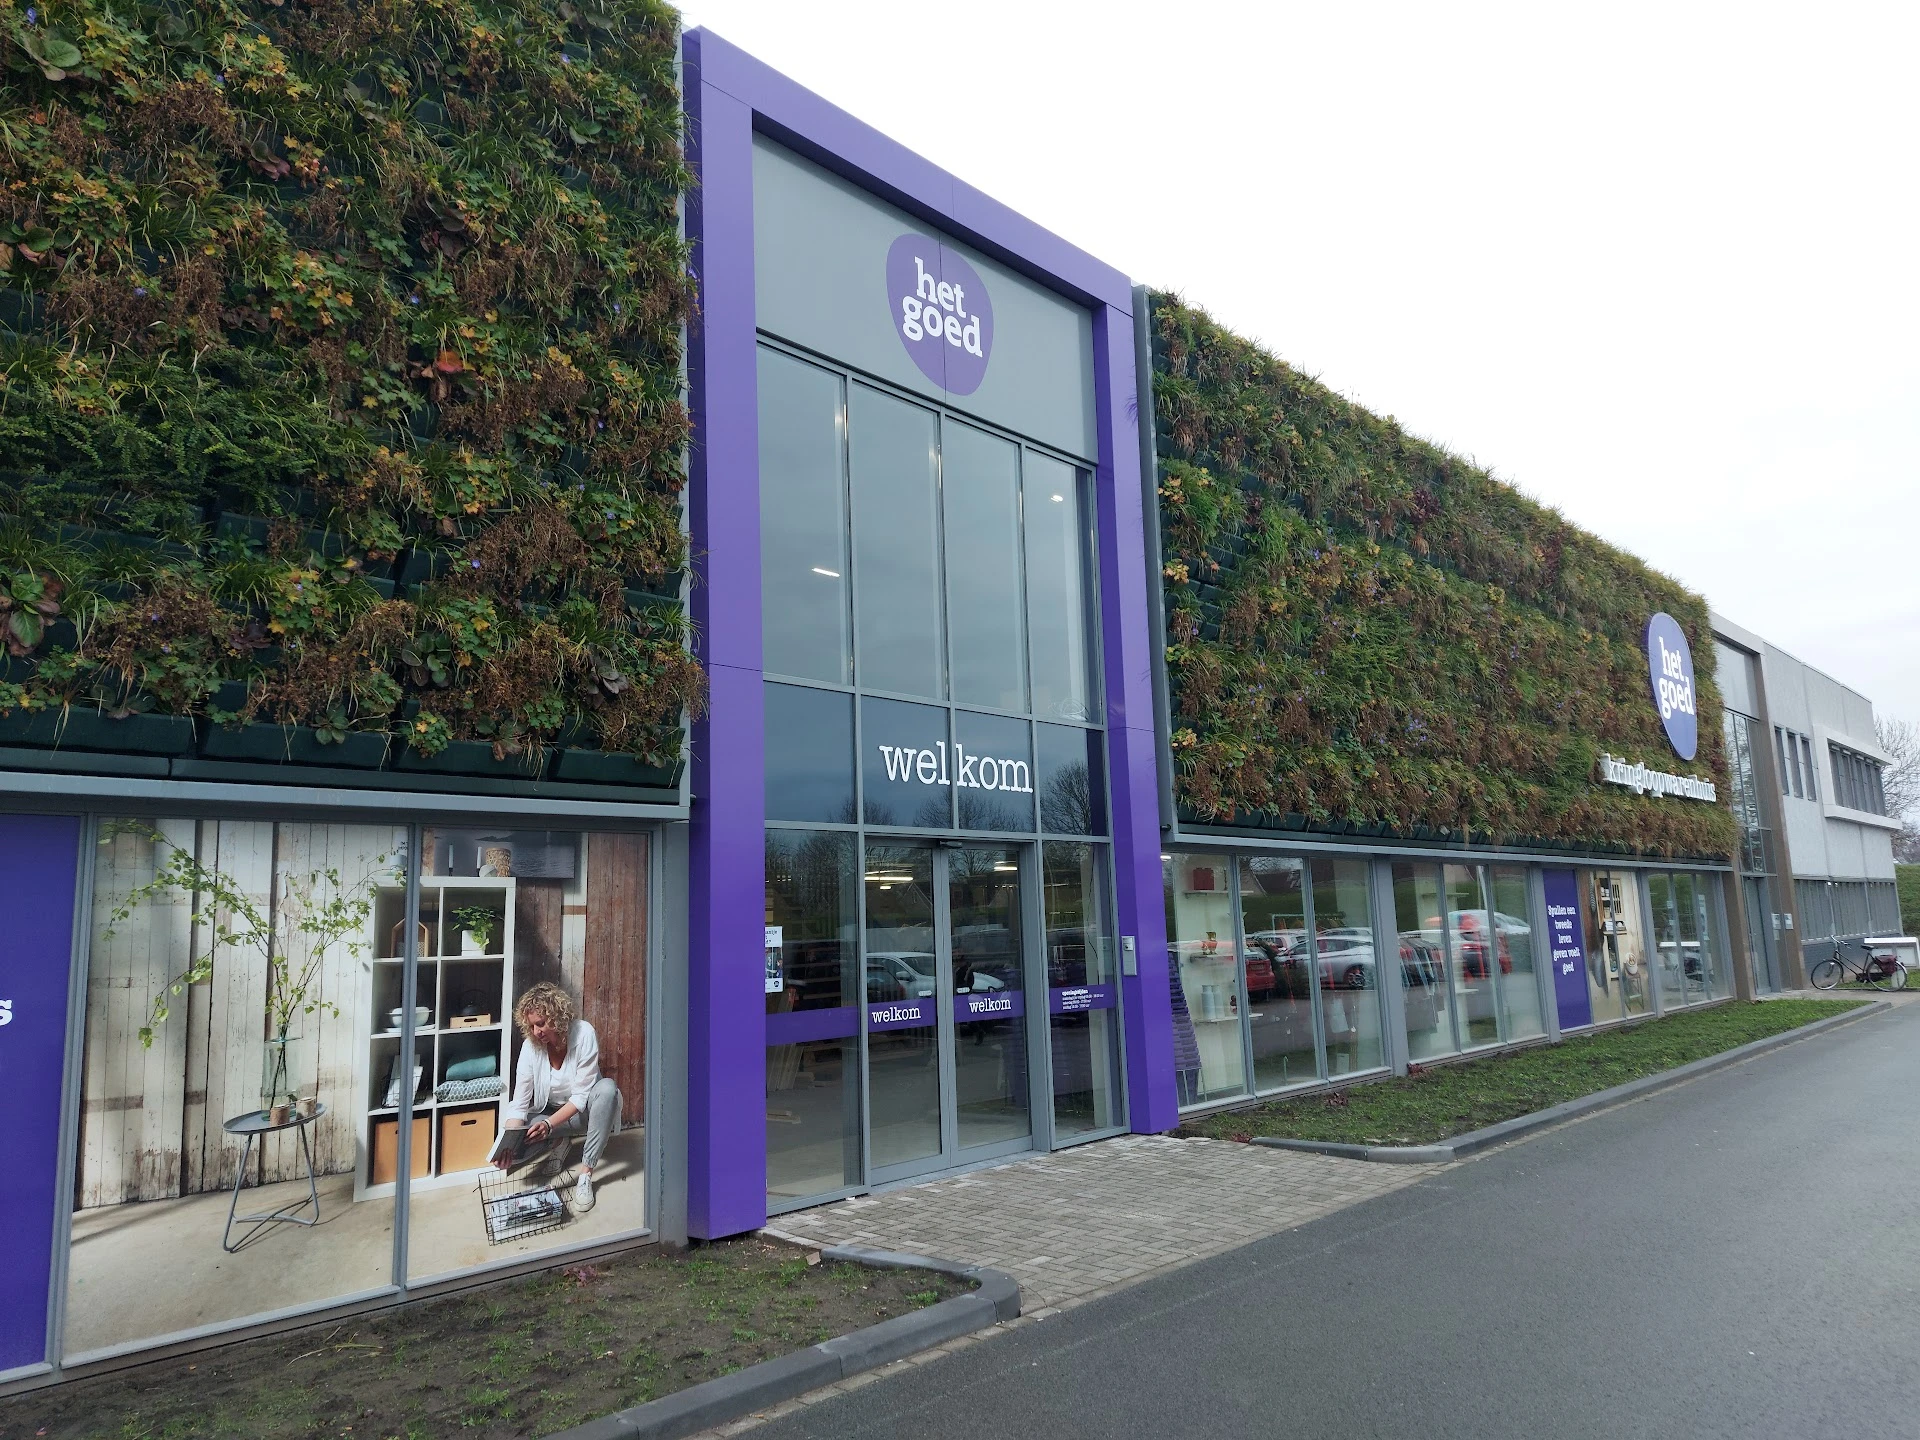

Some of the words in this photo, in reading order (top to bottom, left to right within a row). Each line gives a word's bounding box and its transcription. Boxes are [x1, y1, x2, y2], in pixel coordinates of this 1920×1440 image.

[915, 256, 967, 318] het
[902, 295, 983, 357] goed
[1659, 636, 1684, 681] het
[1659, 676, 1694, 719] goed
[879, 740, 1033, 793] welkom
[1600, 753, 1717, 802] kringloopwarenhuis
[1548, 905, 1567, 917] Spullen
[1567, 906, 1576, 915] een
[1554, 919, 1573, 930] tweede
[1558, 934, 1572, 944] leven
[1553, 949, 1568, 961] geven
[1568, 947, 1580, 957] voelt
[1562, 961, 1575, 975] goed
[968, 998, 1011, 1013] welkom
[871, 1006, 921, 1024] welkom
